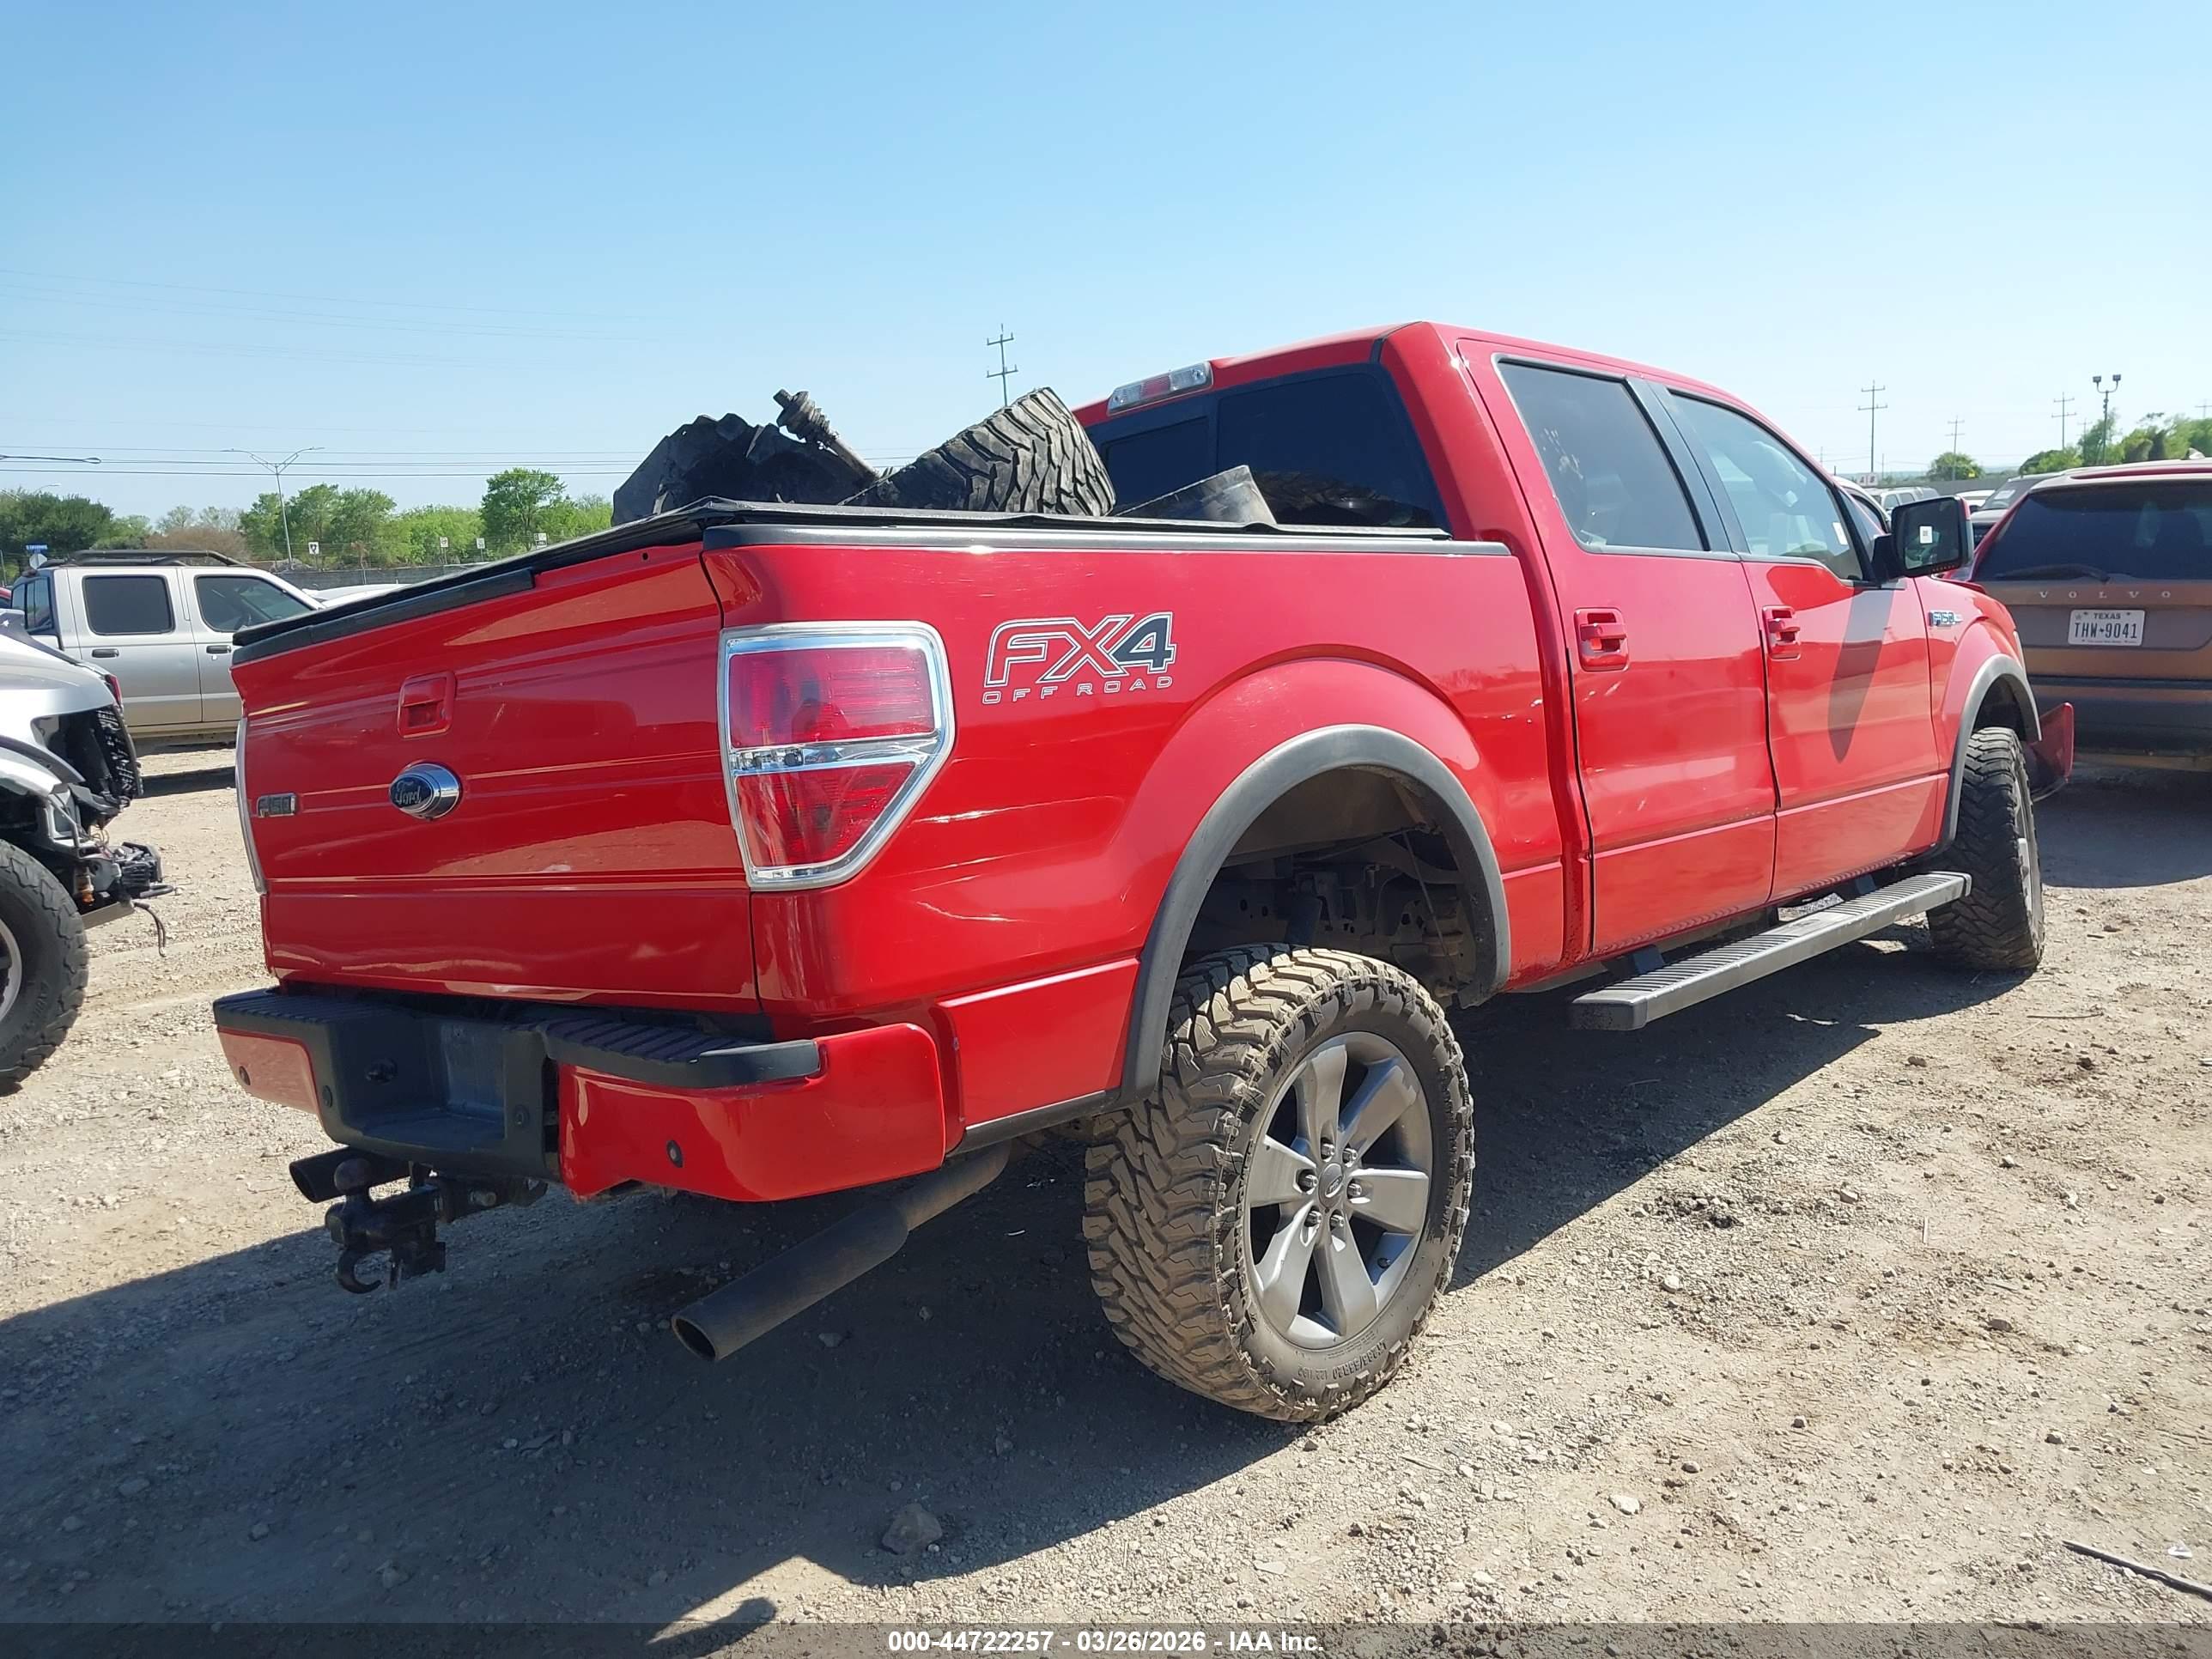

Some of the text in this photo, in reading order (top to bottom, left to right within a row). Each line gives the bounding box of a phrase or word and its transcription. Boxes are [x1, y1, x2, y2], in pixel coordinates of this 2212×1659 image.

[983, 611, 1177, 688] FX4
[981, 676, 1173, 705] OFF ROAD
[395, 780, 422, 805] Ford
